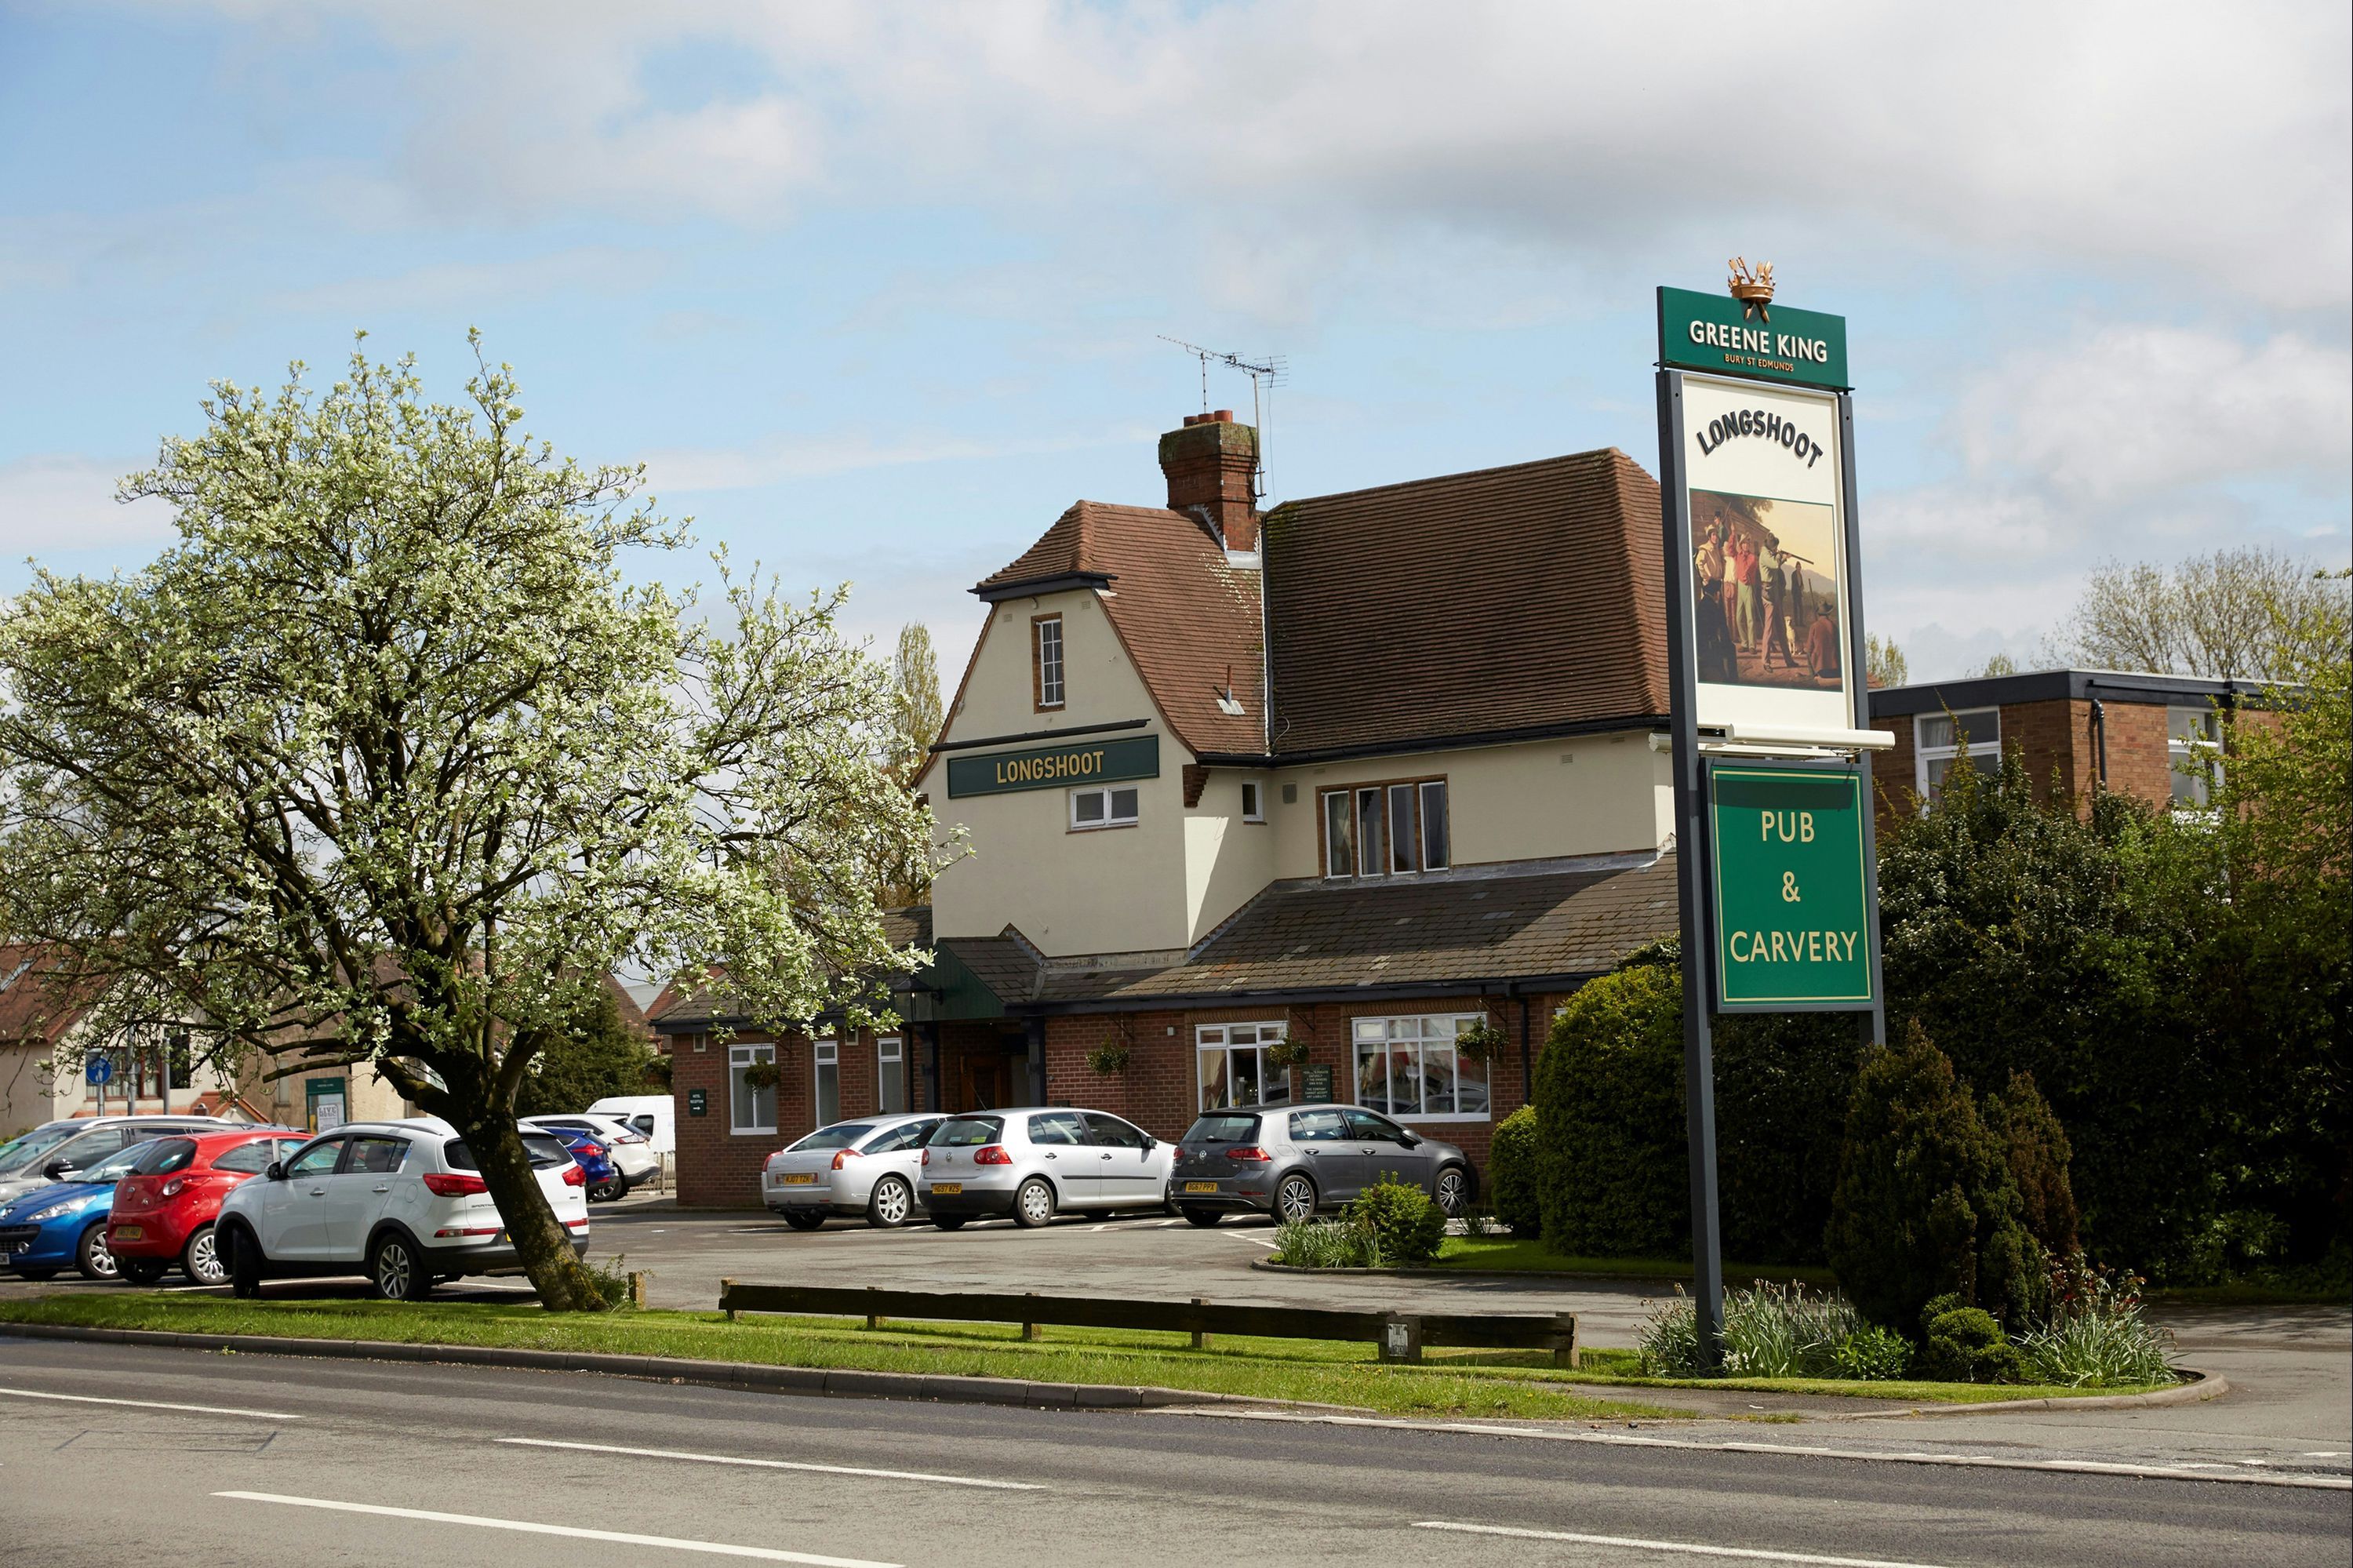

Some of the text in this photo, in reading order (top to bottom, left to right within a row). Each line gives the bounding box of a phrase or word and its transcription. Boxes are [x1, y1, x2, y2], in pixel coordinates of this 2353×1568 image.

[1689, 320, 1827, 363] GREENE KING
[1725, 354, 1795, 373] BURY ST EDMUNDS
[1697, 409, 1824, 468] LONGSHOOT
[996, 751, 1104, 784] LONGSHOOT
[1761, 811, 1815, 842] PUB
[1781, 871, 1801, 902] &
[1729, 930, 1858, 963] CARVERY
